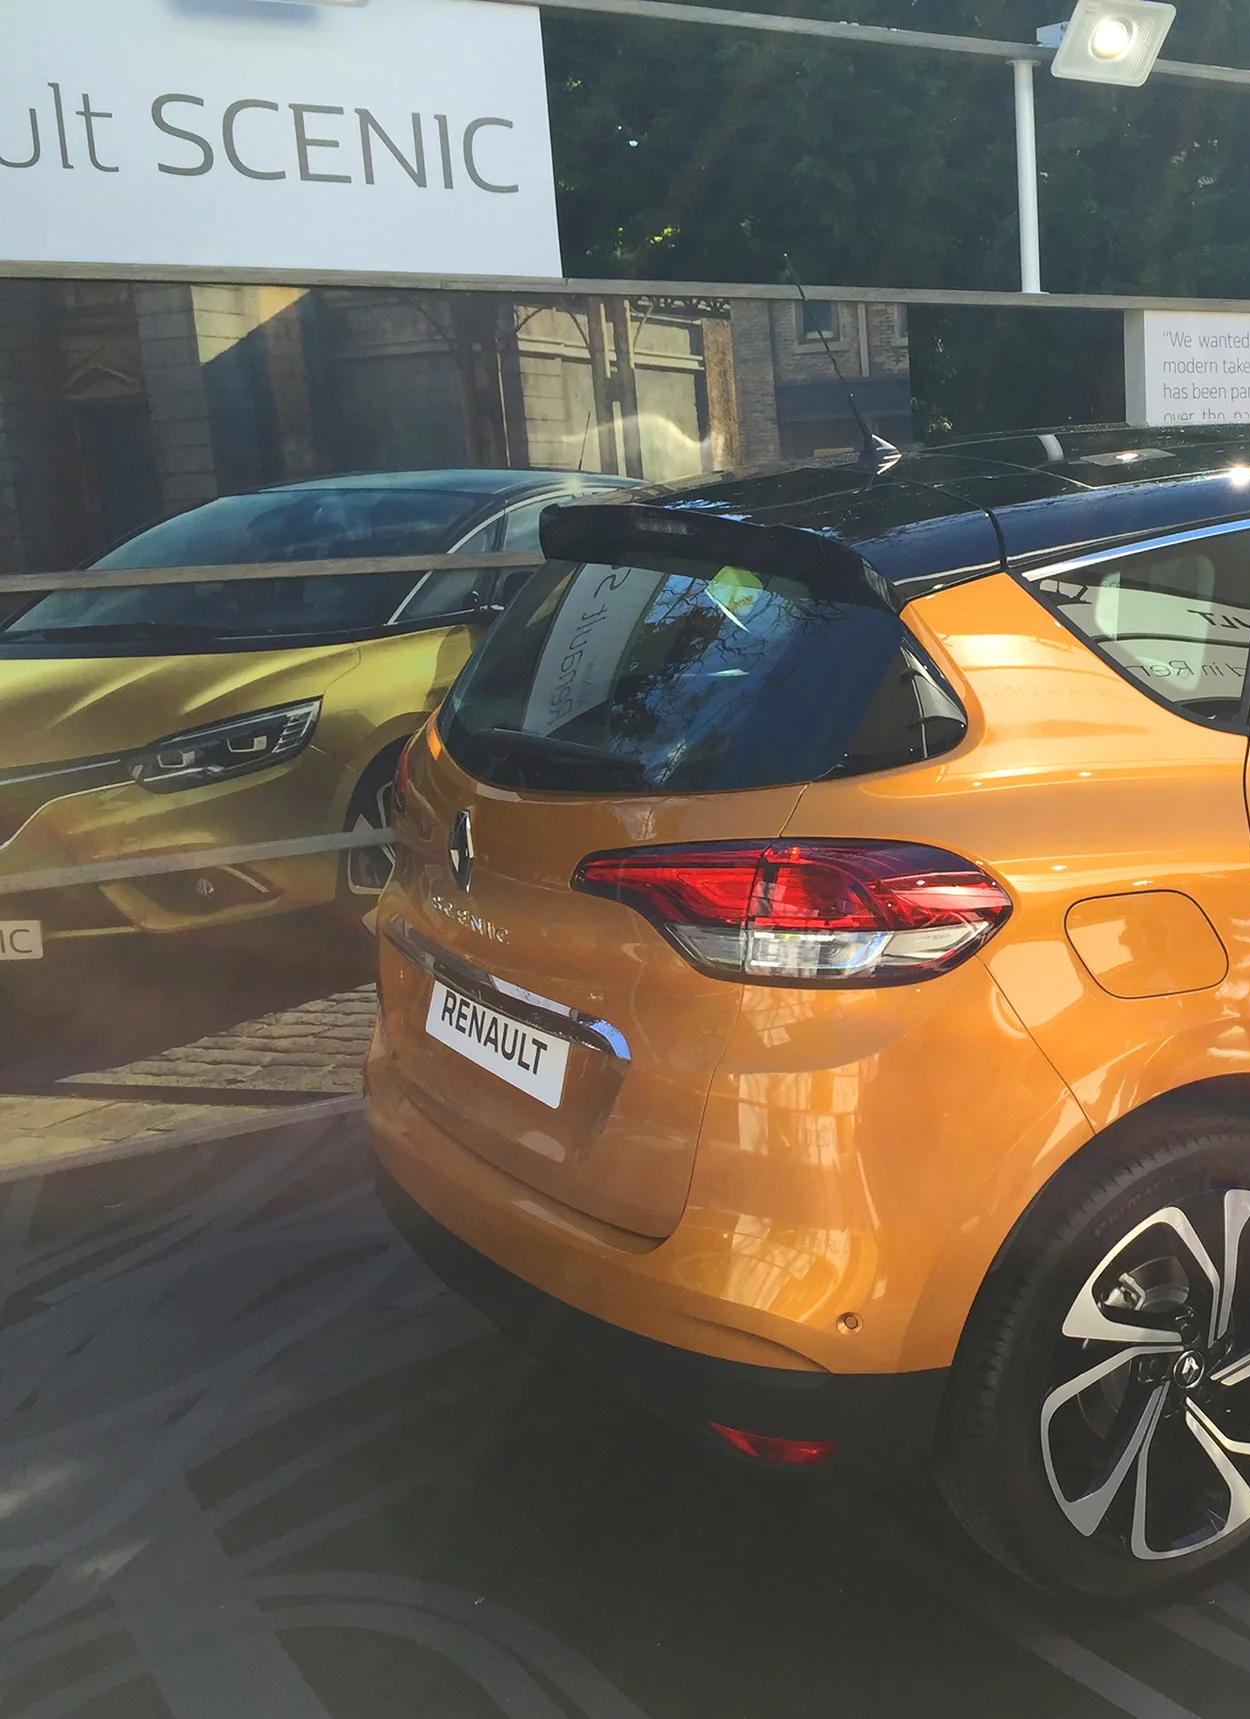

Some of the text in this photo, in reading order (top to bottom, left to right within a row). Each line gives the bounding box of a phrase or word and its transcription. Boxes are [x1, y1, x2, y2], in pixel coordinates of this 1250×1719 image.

[150, 92, 519, 194] SCENIC
[1199, 333, 1250, 349] wanted
[1163, 358, 1218, 374] modern
[1223, 358, 1250, 374] take
[1163, 383, 1188, 399] has
[1192, 383, 1227, 399] been
[1164, 412, 1194, 421] over
[1202, 408, 1225, 420] the
[441, 989, 548, 1075] RENAULT
